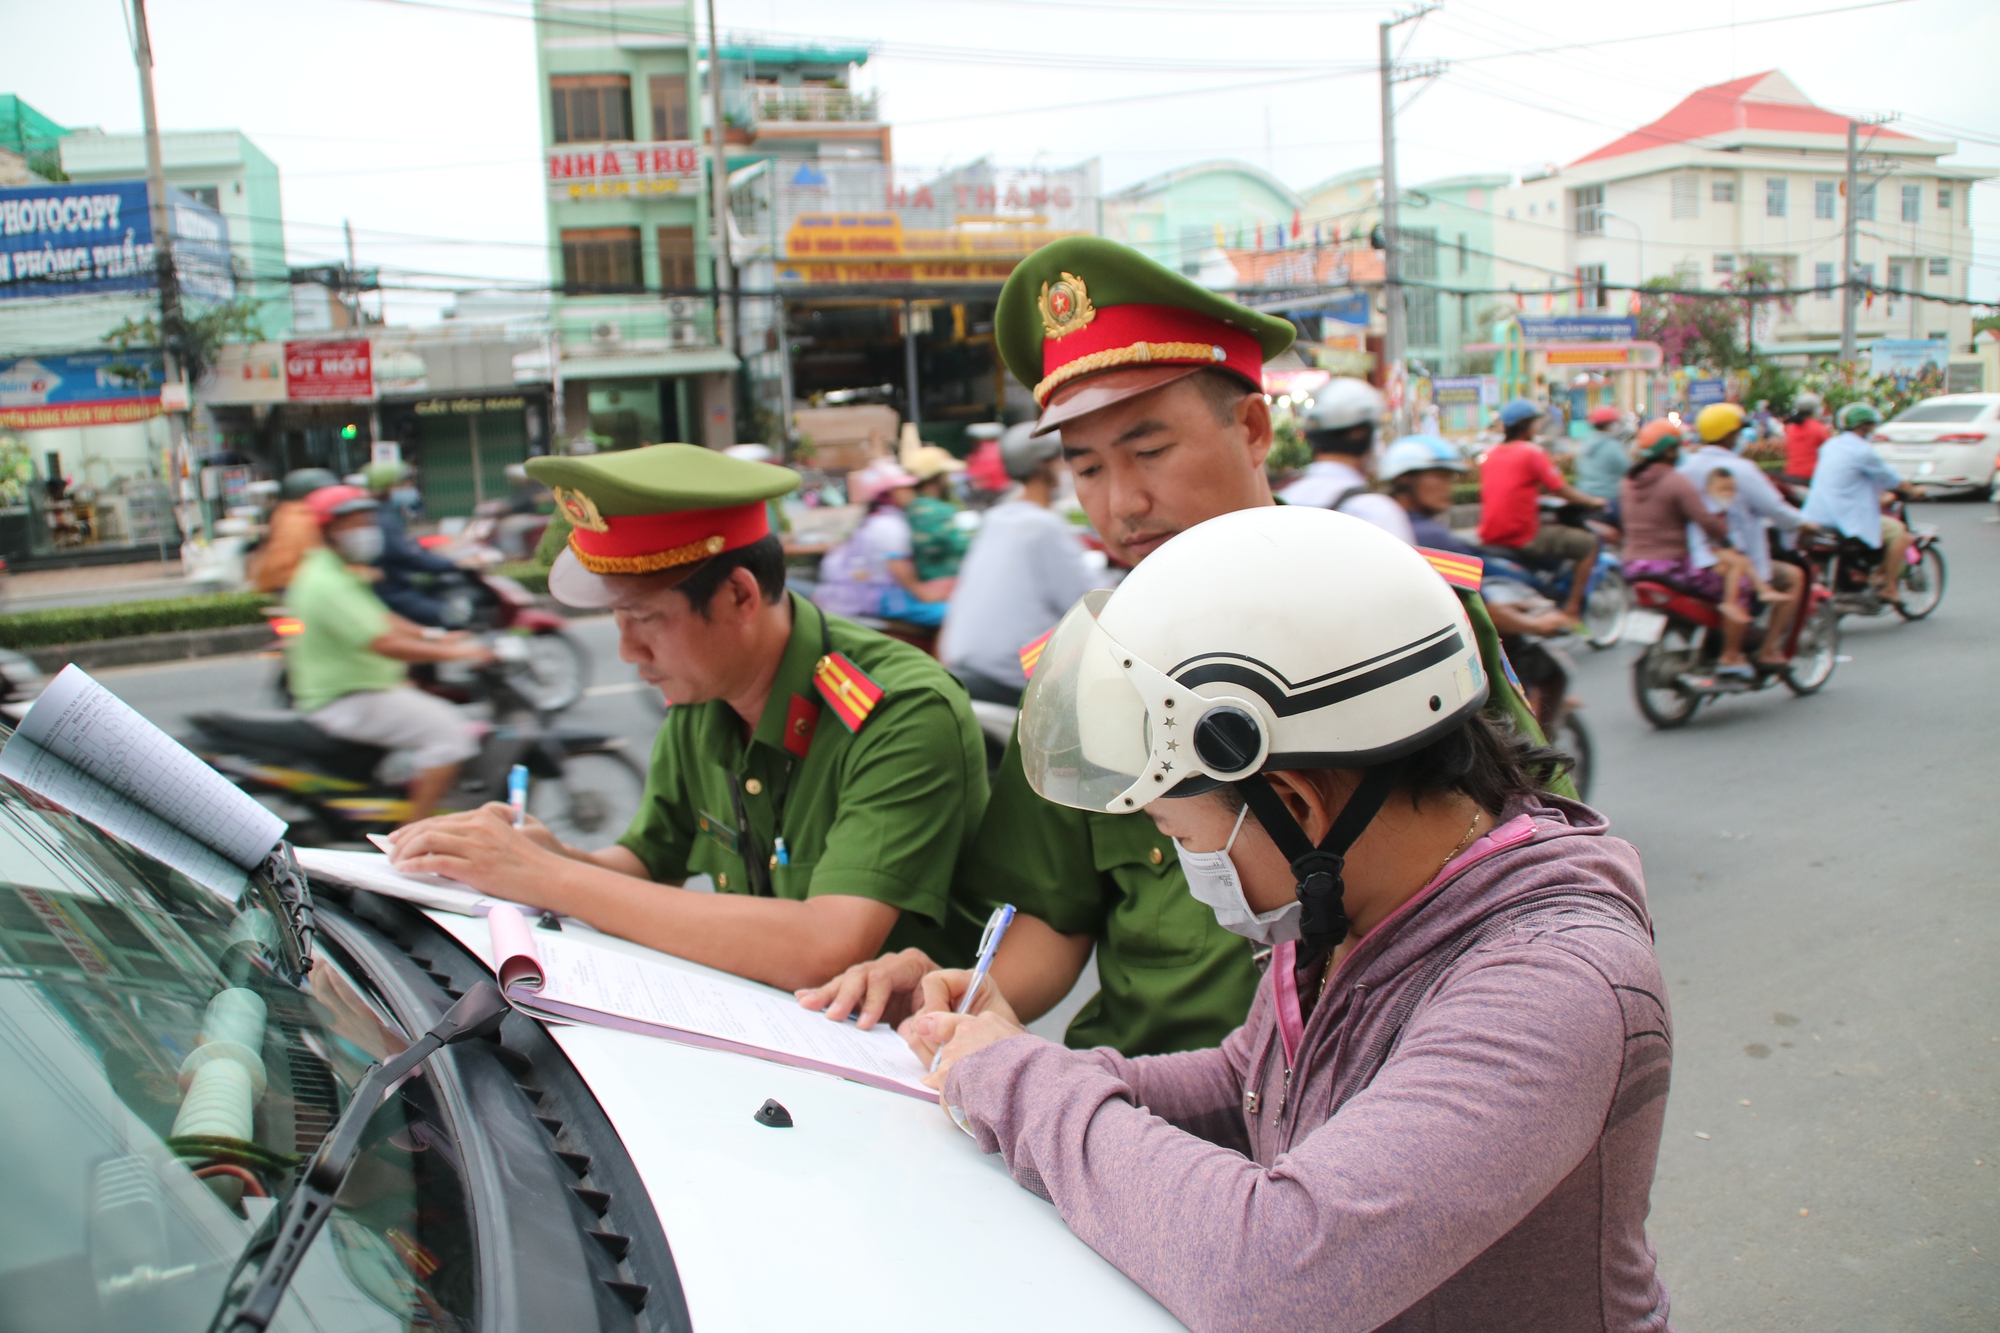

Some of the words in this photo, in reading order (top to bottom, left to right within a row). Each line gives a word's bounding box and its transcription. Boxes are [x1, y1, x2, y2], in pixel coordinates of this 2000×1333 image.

[549, 143, 622, 179] NHÀ
[635, 147, 696, 177] TRỌ
[12, 240, 92, 281] PHÒNG
